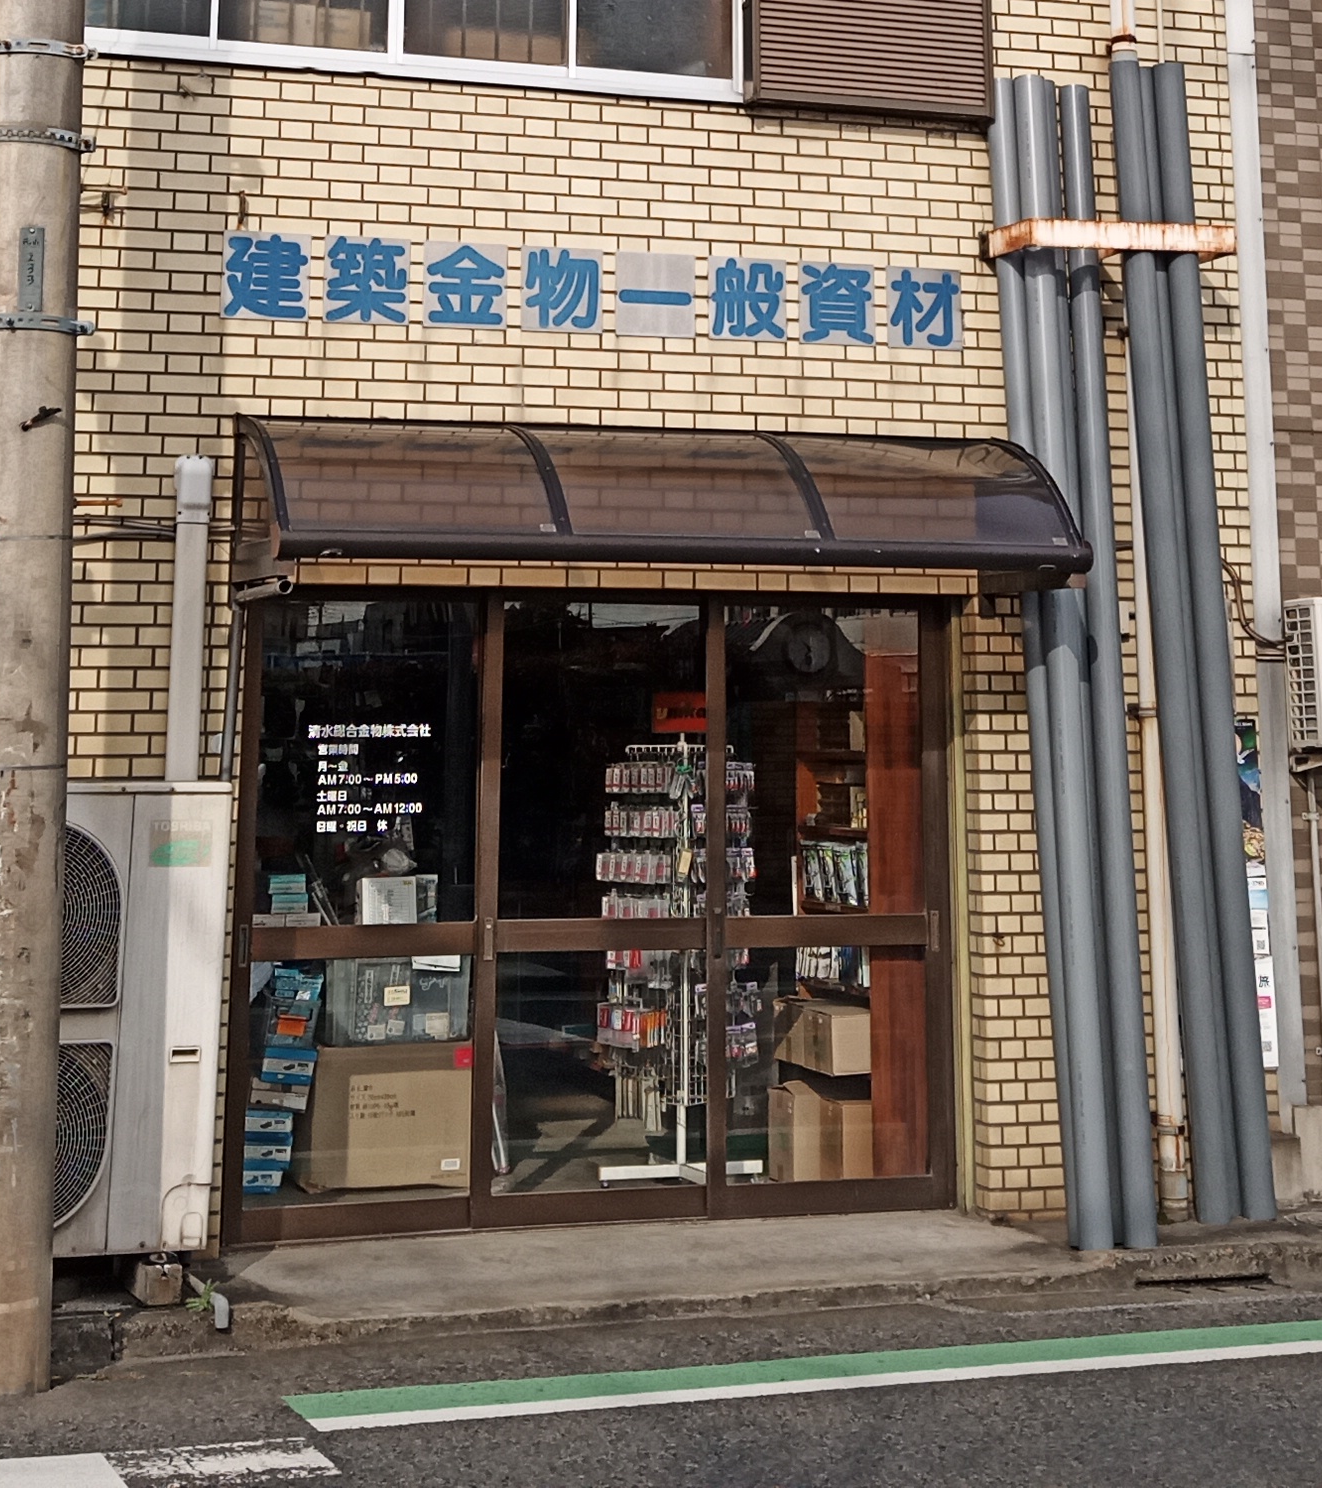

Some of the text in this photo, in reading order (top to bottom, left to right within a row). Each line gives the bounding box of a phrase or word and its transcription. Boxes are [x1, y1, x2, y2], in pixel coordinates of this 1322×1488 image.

[224, 233, 960, 347] 建築金物一般資材
[316, 790, 347, 802] 土曜日
